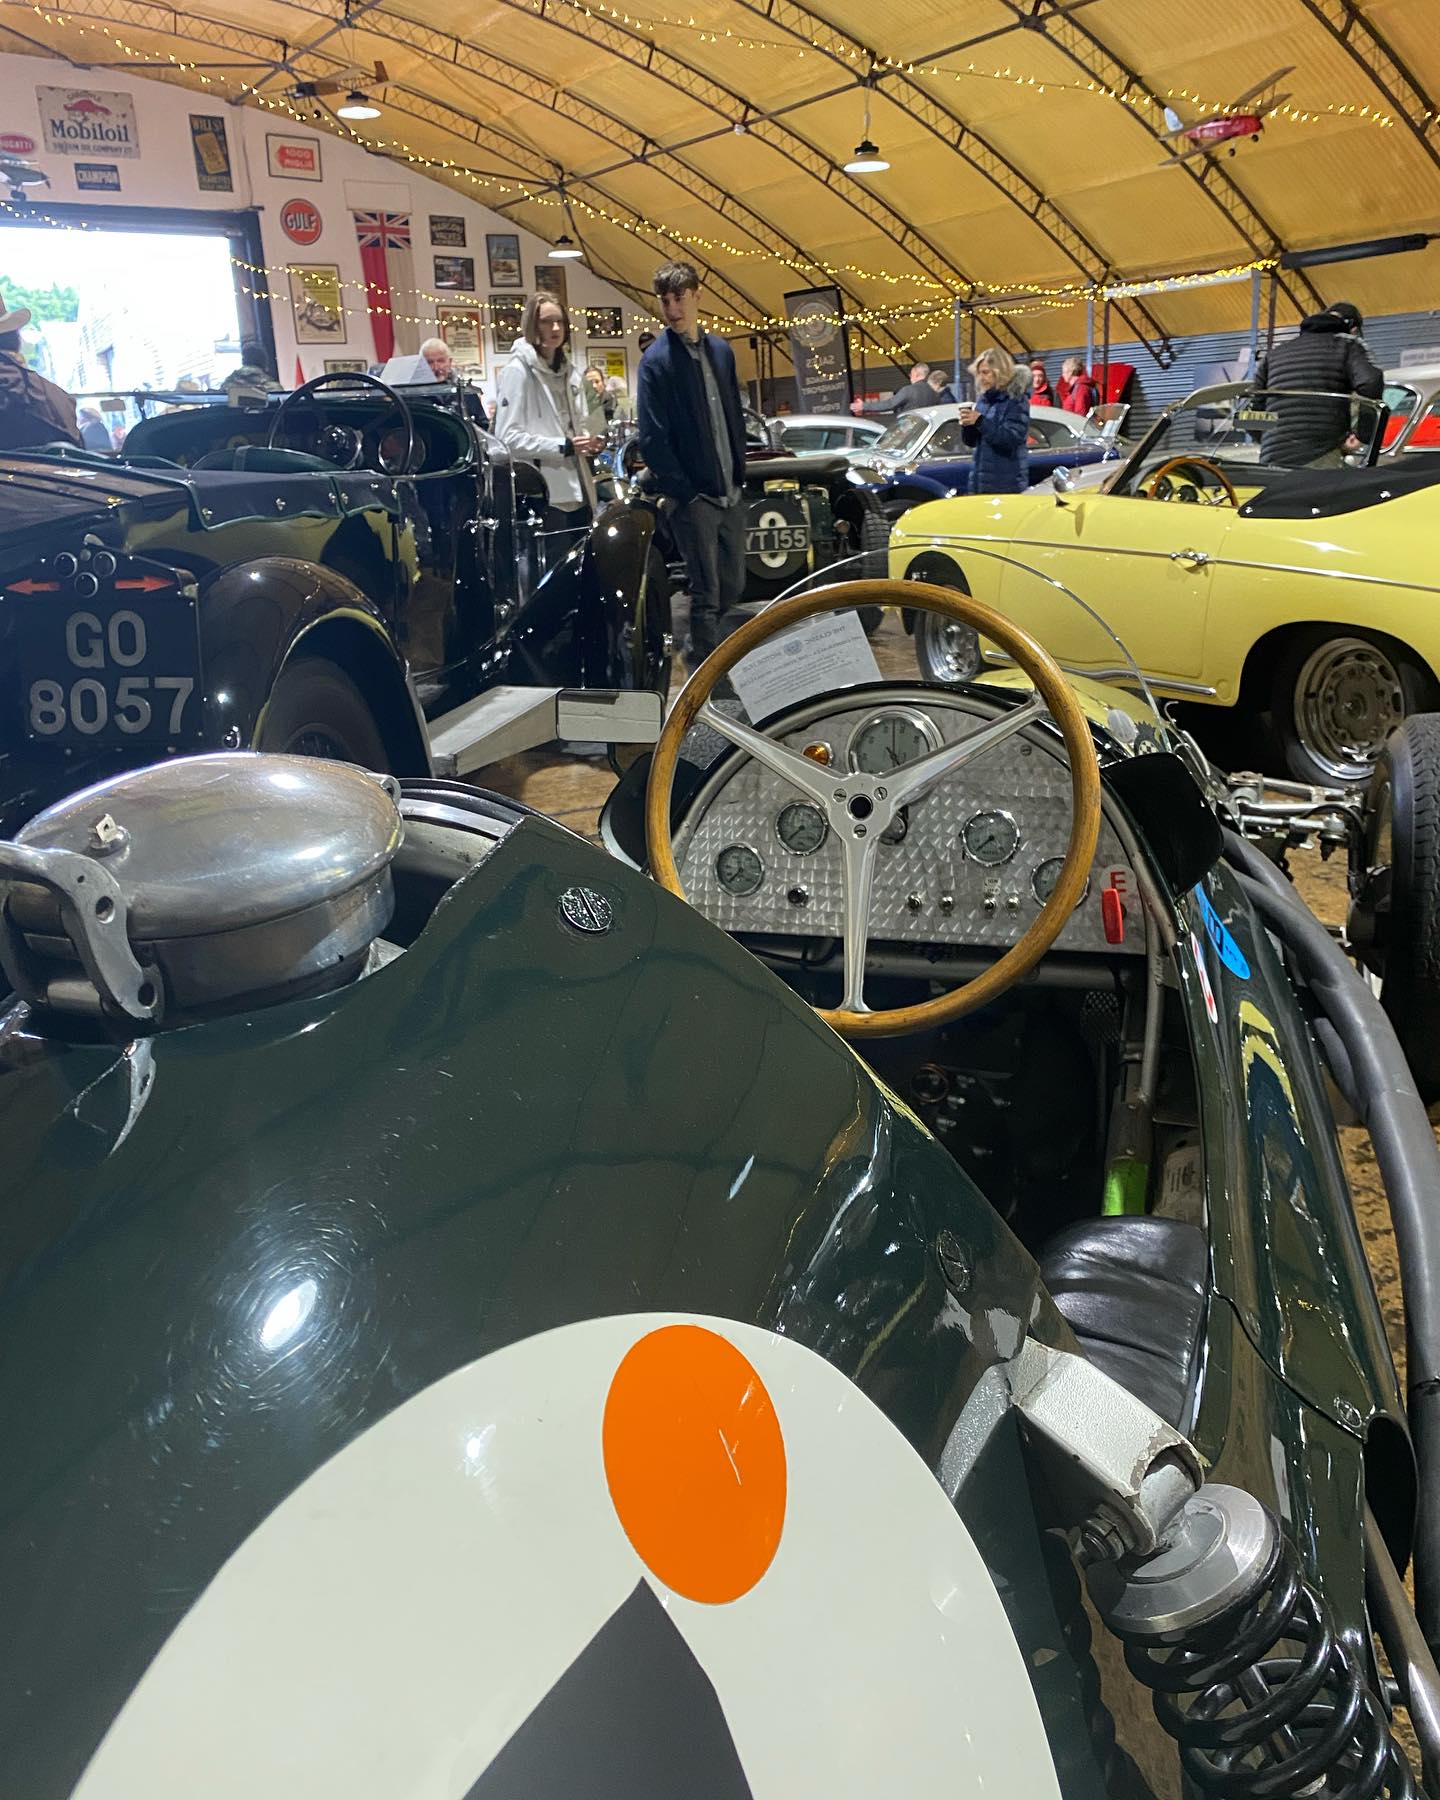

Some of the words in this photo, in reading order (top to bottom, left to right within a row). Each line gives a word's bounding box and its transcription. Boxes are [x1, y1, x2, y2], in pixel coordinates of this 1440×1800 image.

[50, 118, 130, 142] Mobiloil
[286, 148, 311, 159] 1000
[286, 212, 317, 232] GULF
[772, 529, 807, 549] 155
[66, 610, 147, 668] GO
[30, 677, 194, 735] 8057
[1110, 871, 1127, 893] E
